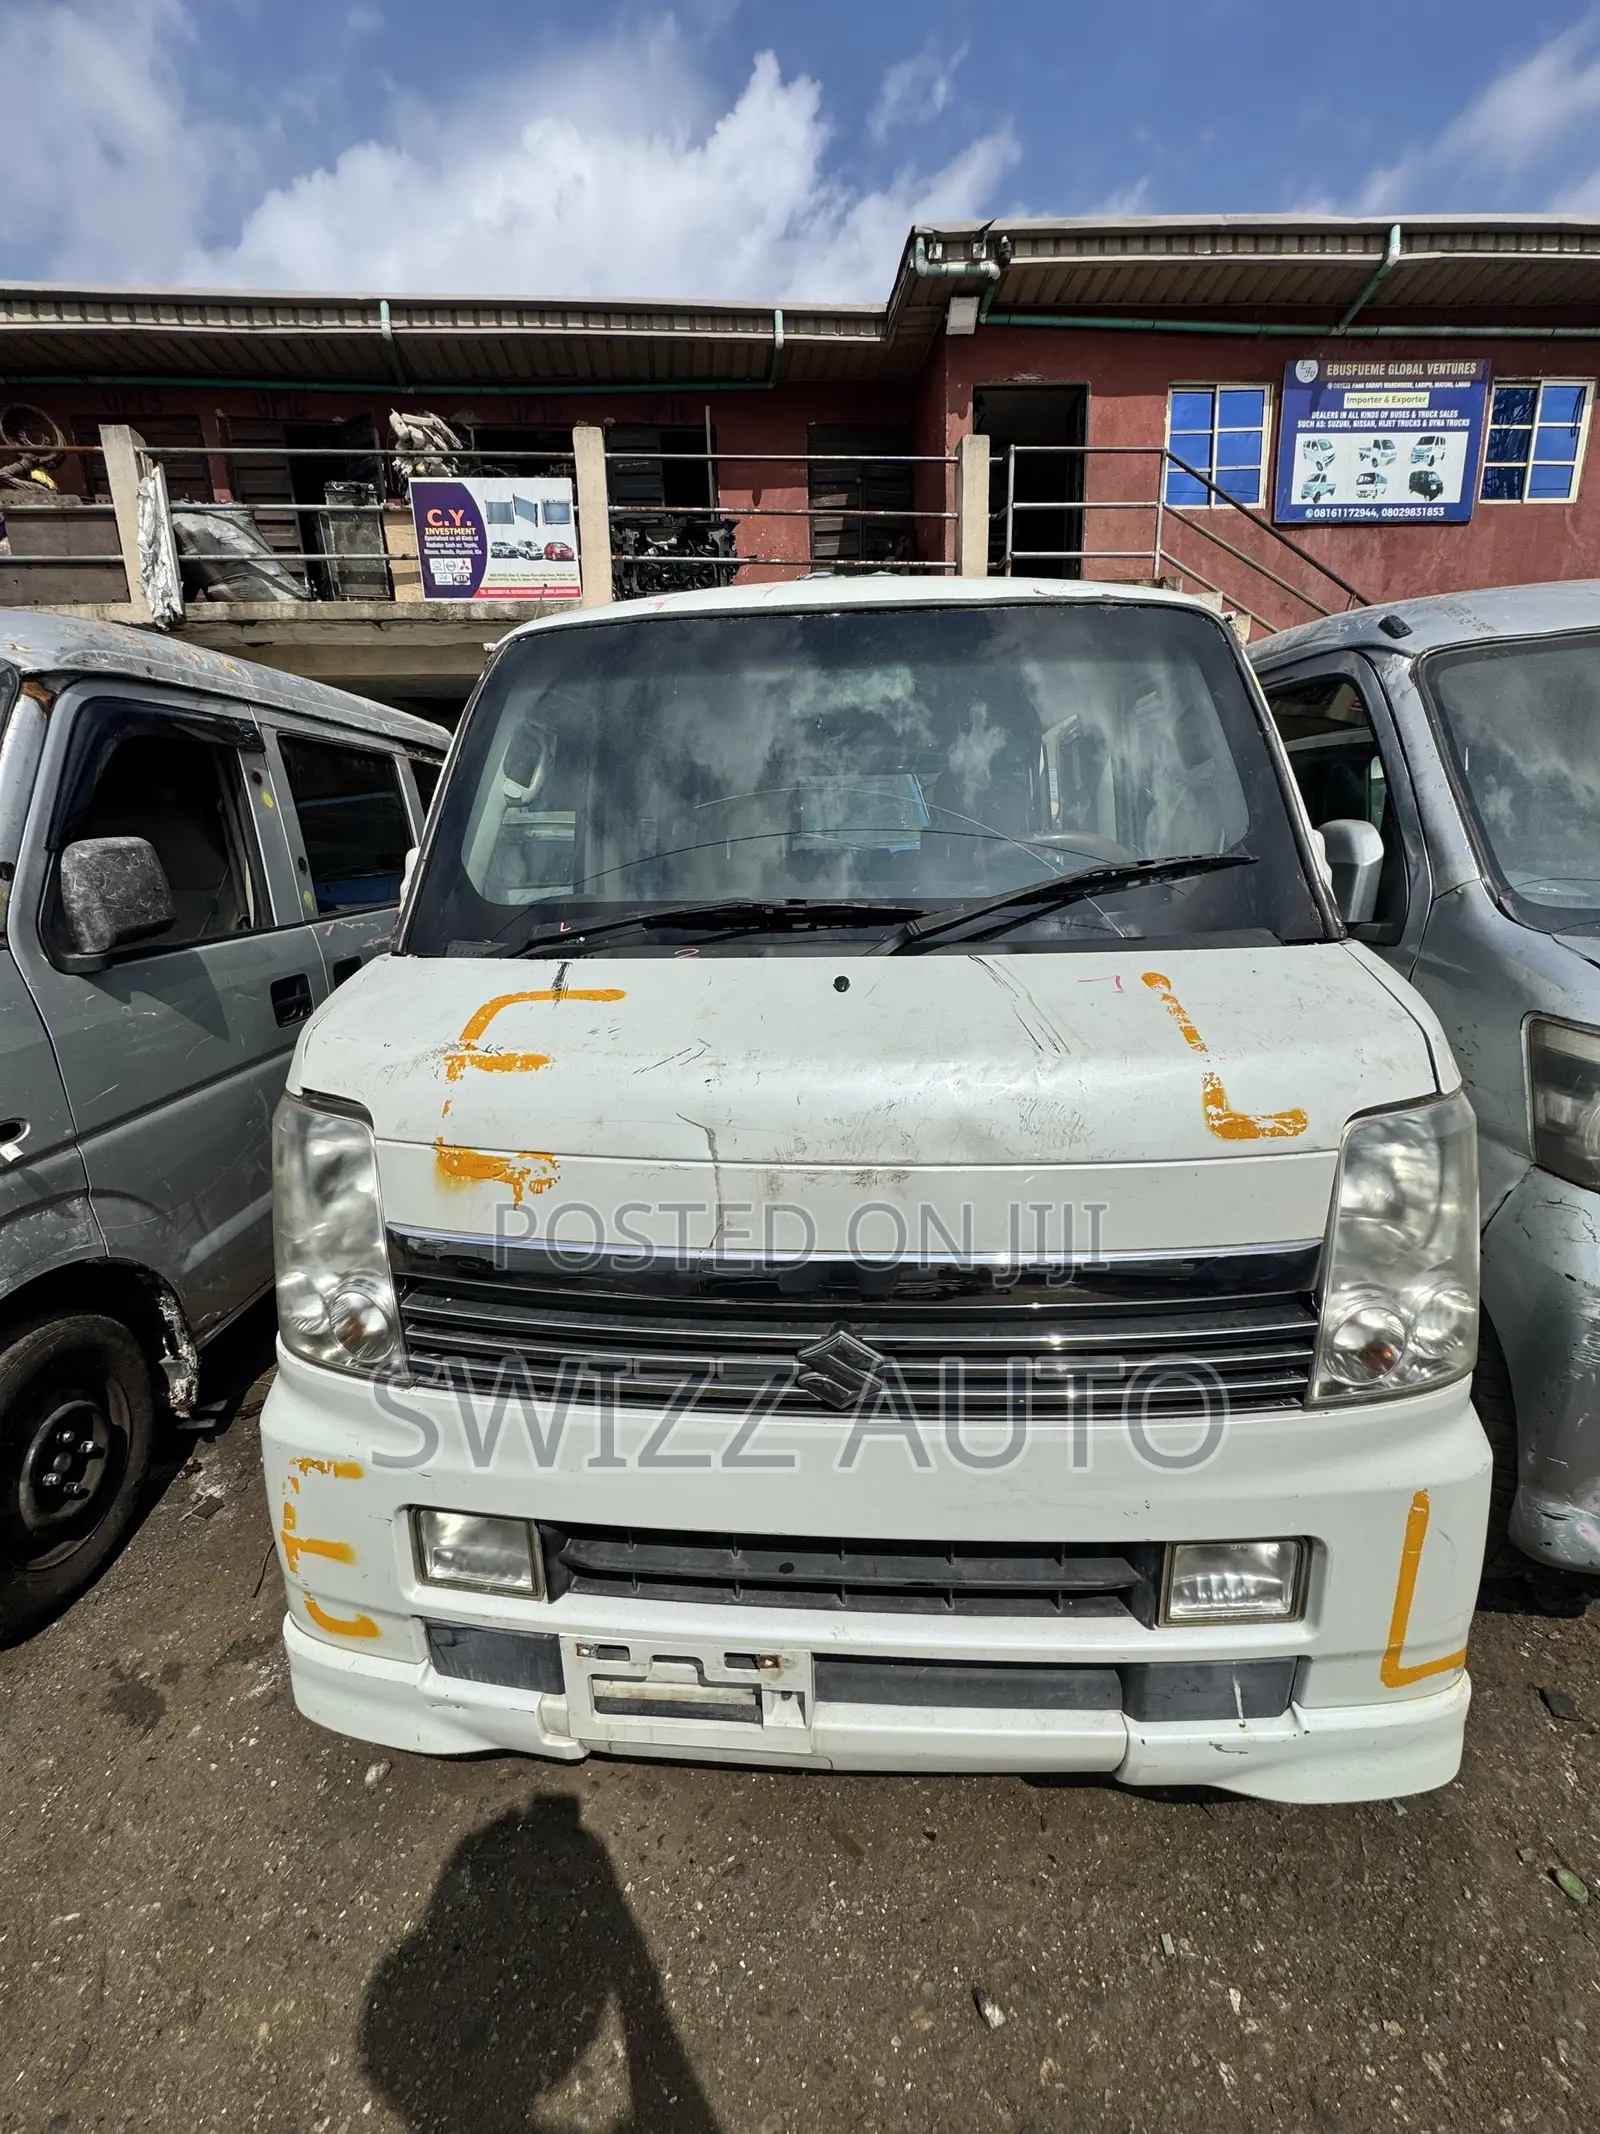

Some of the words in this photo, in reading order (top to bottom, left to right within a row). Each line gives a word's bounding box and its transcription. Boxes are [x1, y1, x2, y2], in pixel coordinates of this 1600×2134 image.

[1326, 364, 1385, 376] EBUSFUEME
[1388, 363, 1424, 375] GLOBAL
[1427, 362, 1476, 375] VENTURES
[1346, 396, 1382, 405] Importer
[1392, 396, 1426, 404] Exporter
[1312, 411, 1339, 419] DEALERS
[1340, 411, 1347, 419] IN
[1348, 411, 1360, 419] ALL
[1360, 411, 1379, 419] KINDS
[1380, 410, 1389, 419] OF
[1390, 410, 1410, 418] BUSES
[1411, 410, 1416, 418] &
[1418, 410, 1438, 418] TRUCK
[1439, 410, 1458, 418] SALES
[1297, 420, 1314, 428] SUCH
[1316, 420, 1326, 428] AS:
[1328, 420, 1352, 430] SUZUKI,
[1352, 420, 1377, 428] NISSAN,
[1378, 420, 1396, 428] HIJET
[1397, 419, 1421, 428] TRUCKS
[1422, 419, 1428, 428] &
[1428, 419, 1445, 428] DYNA
[1446, 418, 1470, 428] TRUCKS
[427, 509, 472, 526] C.Y.
[1314, 508, 1379, 518] 08161172944,
[1381, 507, 1444, 517] 08029831853
[424, 528, 476, 536] INVESTMENT
